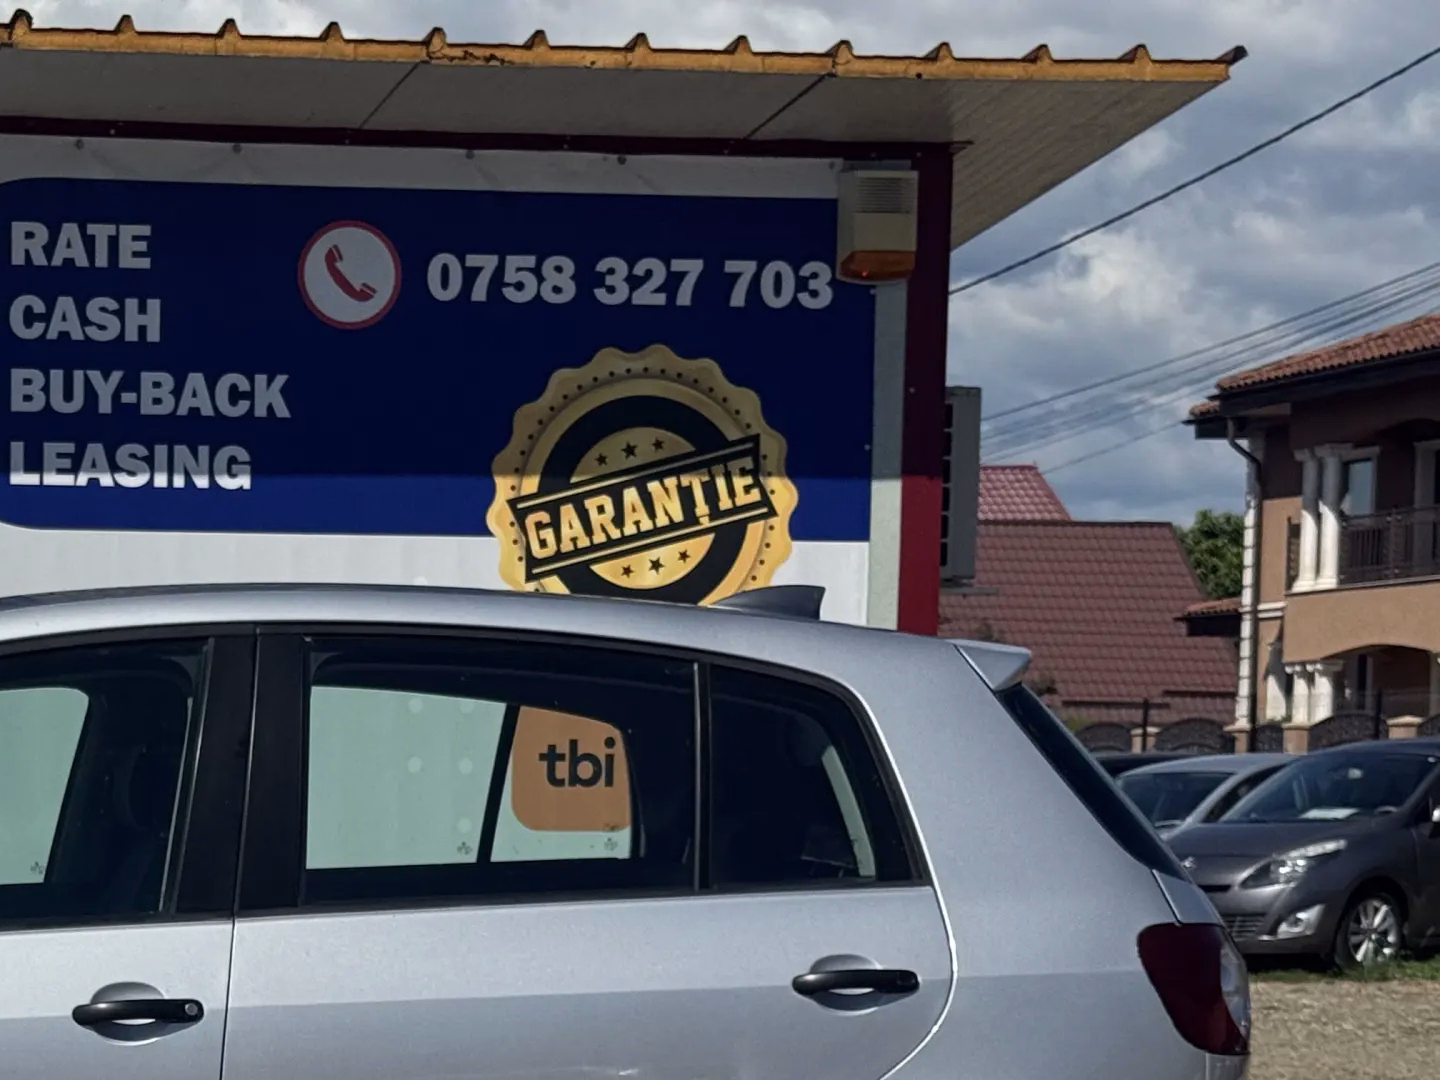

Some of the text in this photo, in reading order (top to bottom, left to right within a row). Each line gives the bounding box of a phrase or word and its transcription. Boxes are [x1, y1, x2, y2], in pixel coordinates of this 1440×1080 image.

[10, 221, 152, 269] RATE
[426, 252, 834, 310] 0758 327 703
[8, 295, 161, 343] CASH
[9, 368, 292, 418] BUY-BACK
[8, 441, 252, 490] LEASING
[538, 736, 616, 788] tbi
